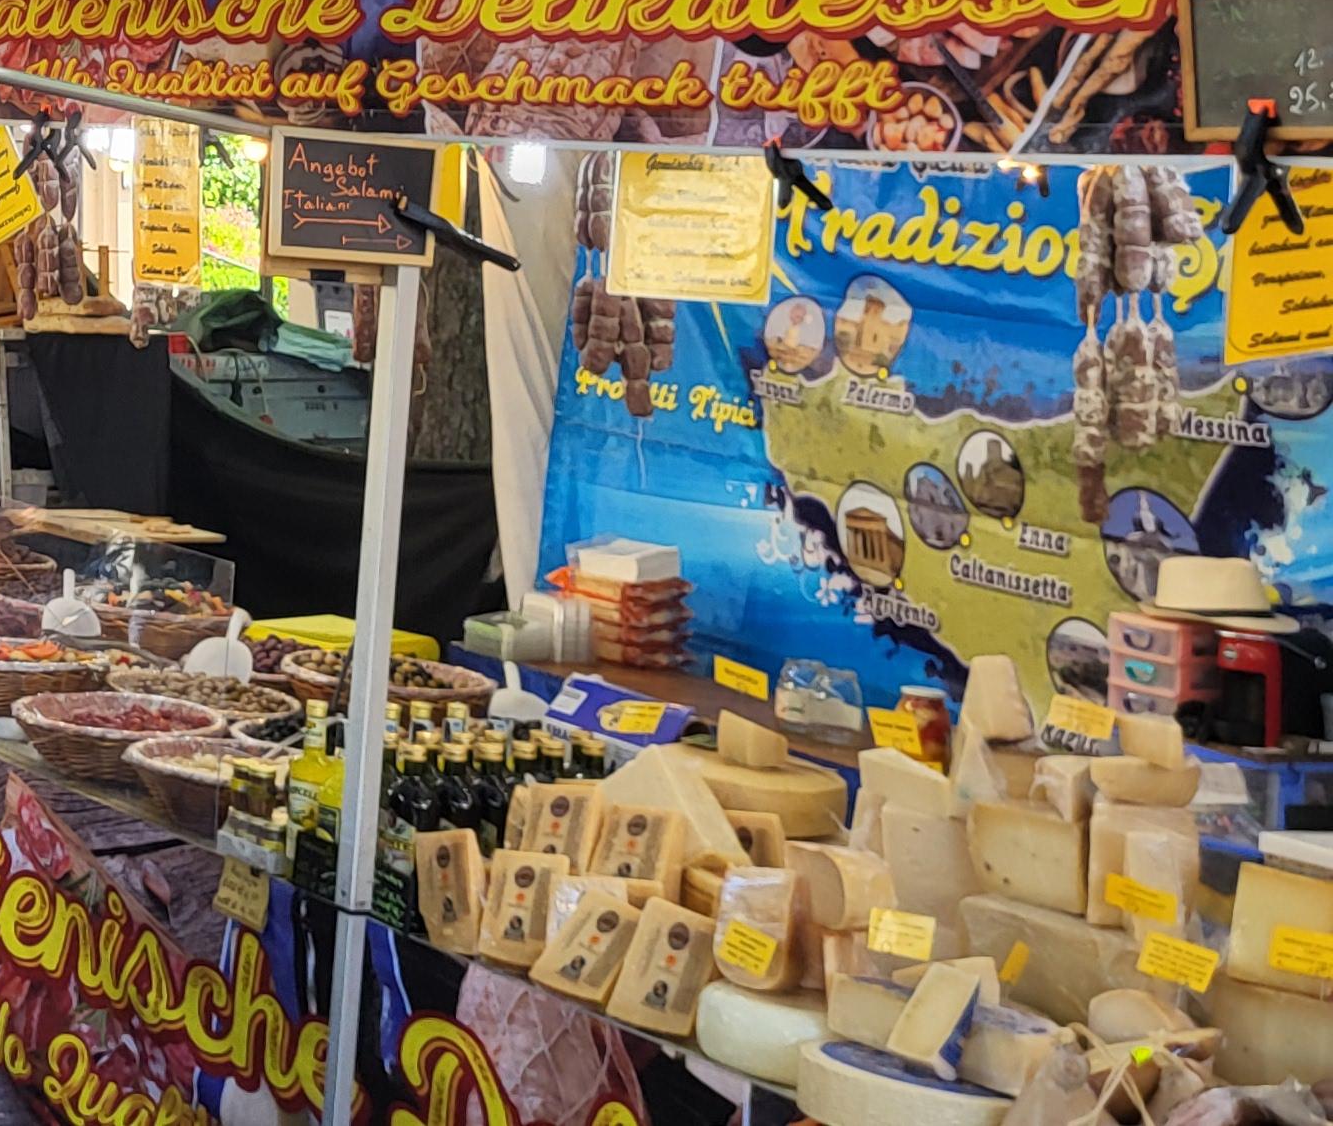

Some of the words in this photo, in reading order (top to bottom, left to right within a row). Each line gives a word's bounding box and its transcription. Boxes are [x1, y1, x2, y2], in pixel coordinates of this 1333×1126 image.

[280, 60, 367, 117] auf
[374, 59, 712, 116] Geschmack
[719, 58, 903, 128] trifft
[288, 142, 379, 182] Angebot
[846, 378, 913, 412] Palermo
[1019, 522, 1066, 551] Enna
[949, 553, 1070, 603] Caltanissetta
